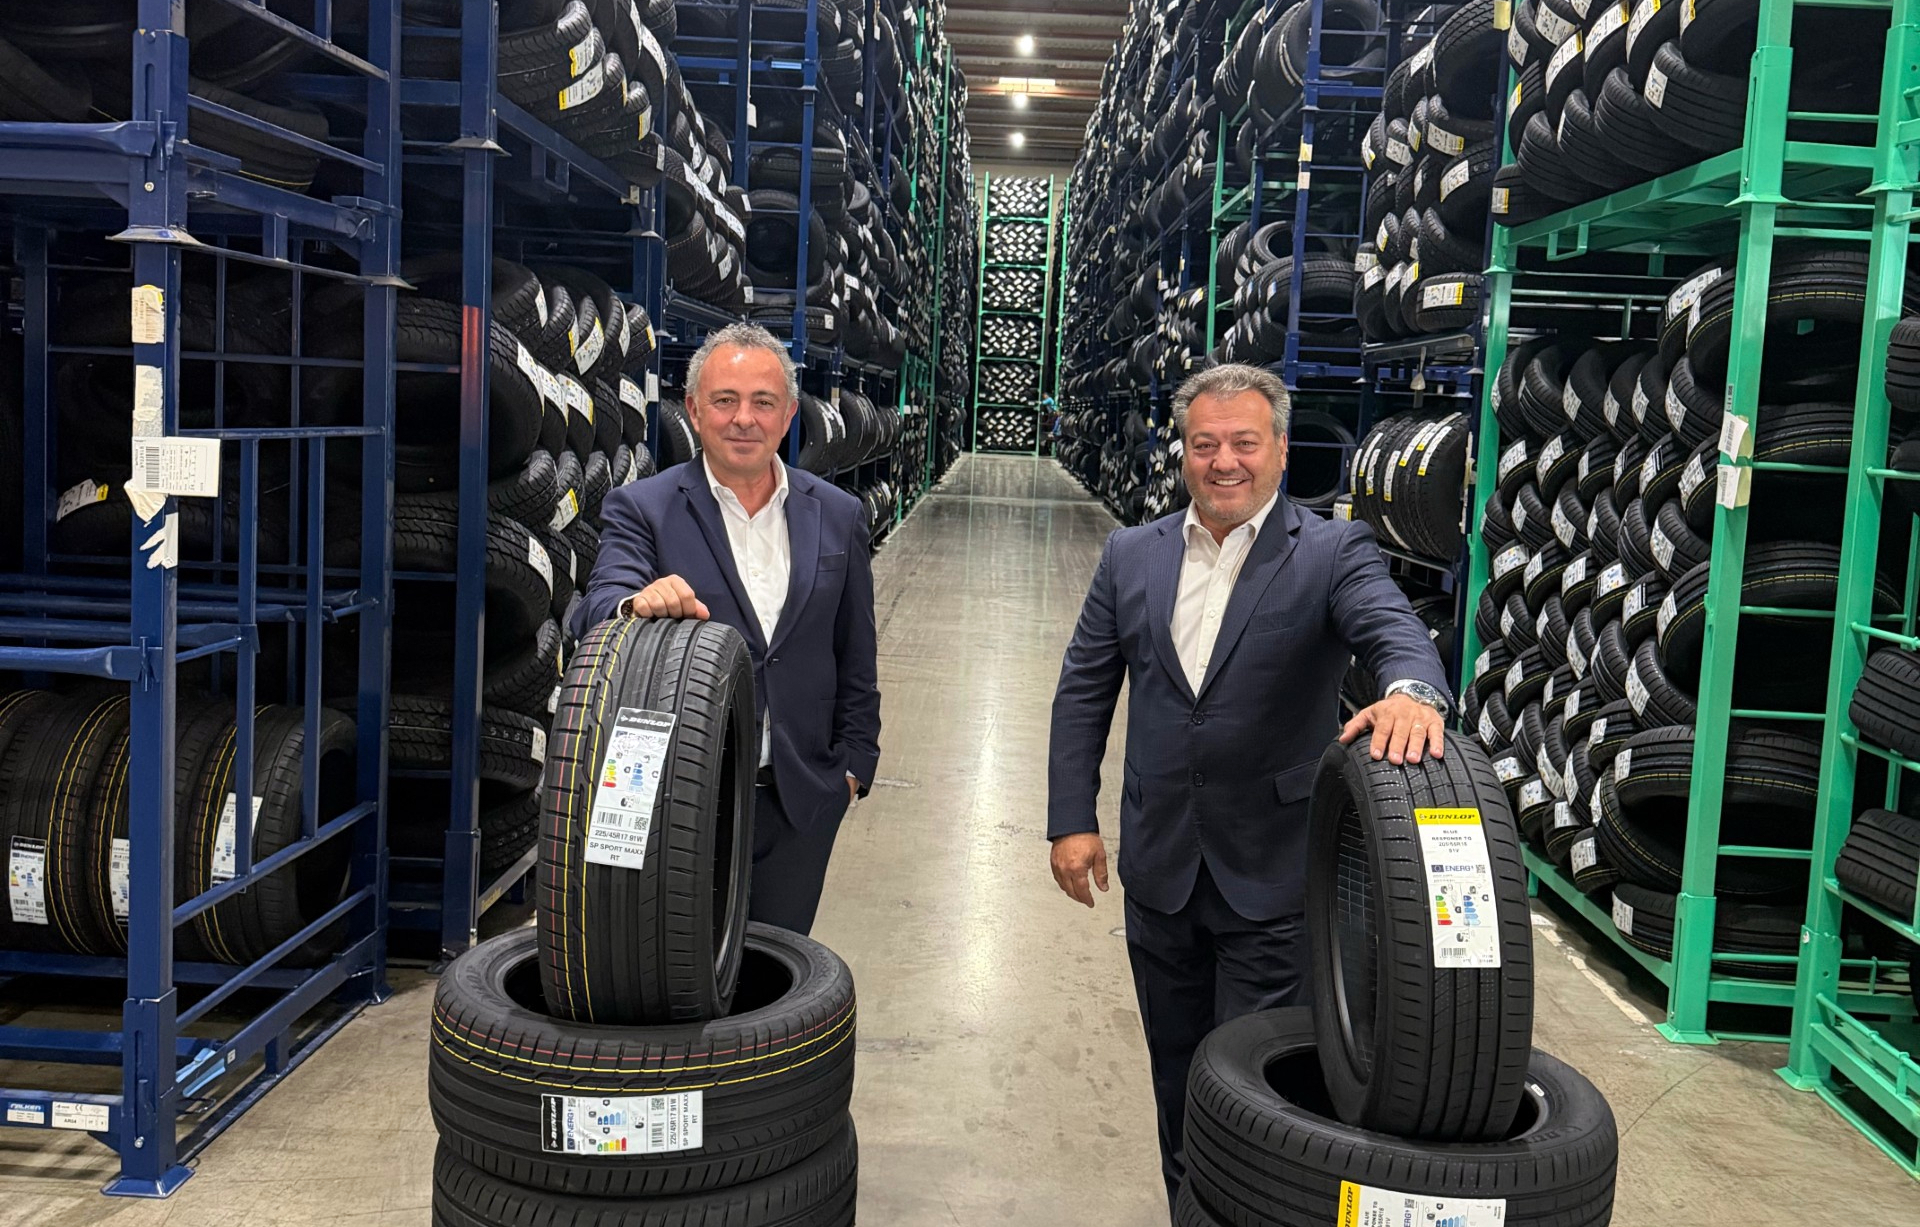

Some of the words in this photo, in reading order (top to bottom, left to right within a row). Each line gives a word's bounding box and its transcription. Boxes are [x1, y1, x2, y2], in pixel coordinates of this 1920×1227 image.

[628, 717, 671, 727] DUNLOP
[594, 829, 628, 841] 225/45R17
[629, 835, 644, 843] 91W
[600, 843, 623, 851] SPORT
[624, 847, 644, 856] MAXX
[10, 1103, 41, 1111] FALKEN
[691, 1114, 698, 1124] RT
[567, 1112, 575, 1138] ENERG
[683, 1138, 689, 1147] SP
